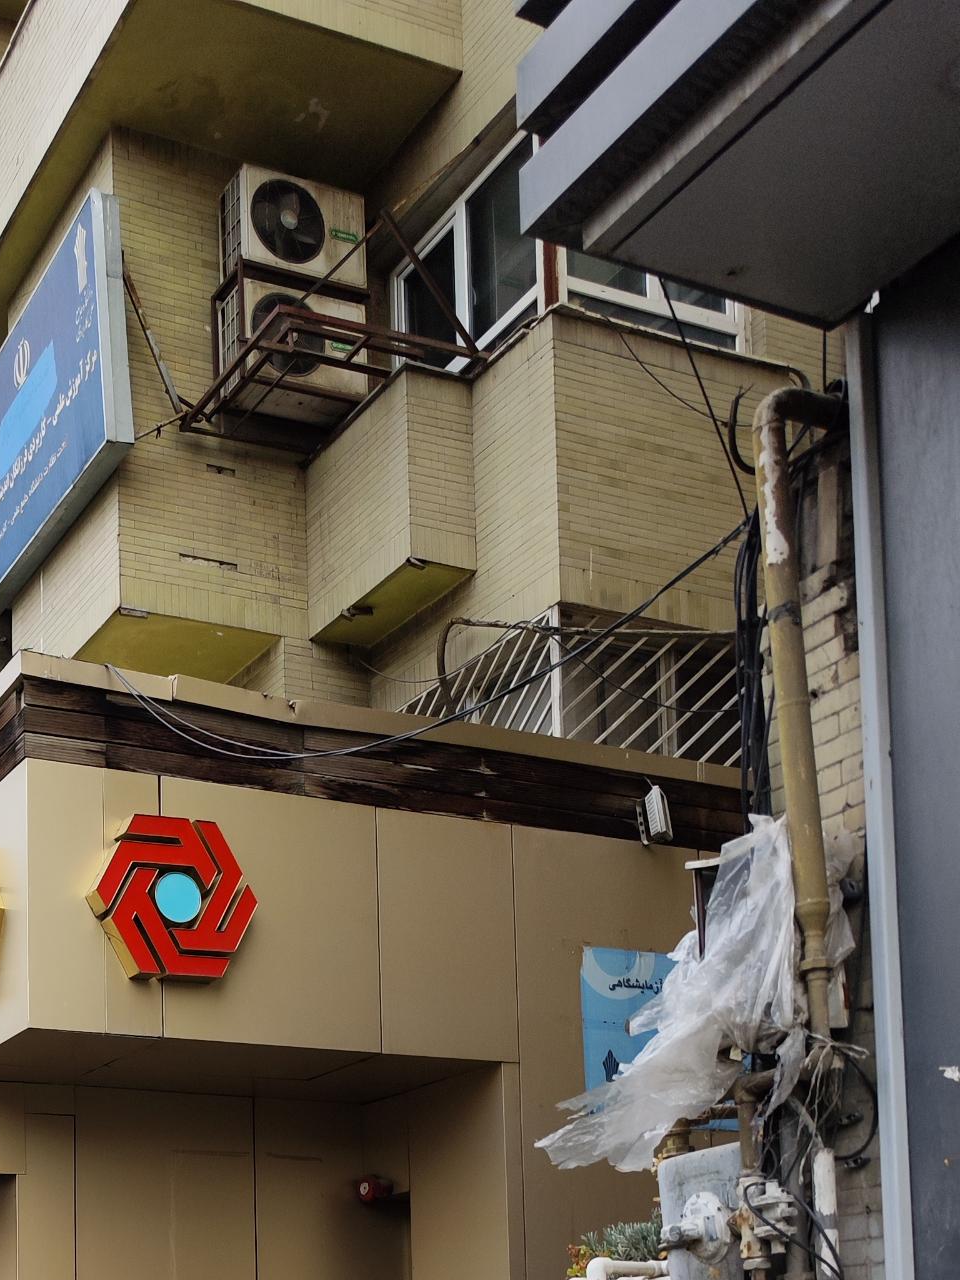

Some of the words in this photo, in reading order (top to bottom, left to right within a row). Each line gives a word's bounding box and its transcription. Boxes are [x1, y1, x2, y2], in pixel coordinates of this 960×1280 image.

[66, 357, 83, 407] آموزش
[84, 349, 97, 382] مرکز
[52, 392, 65, 428] علمی
[27, 416, 46, 462] کاربردی
